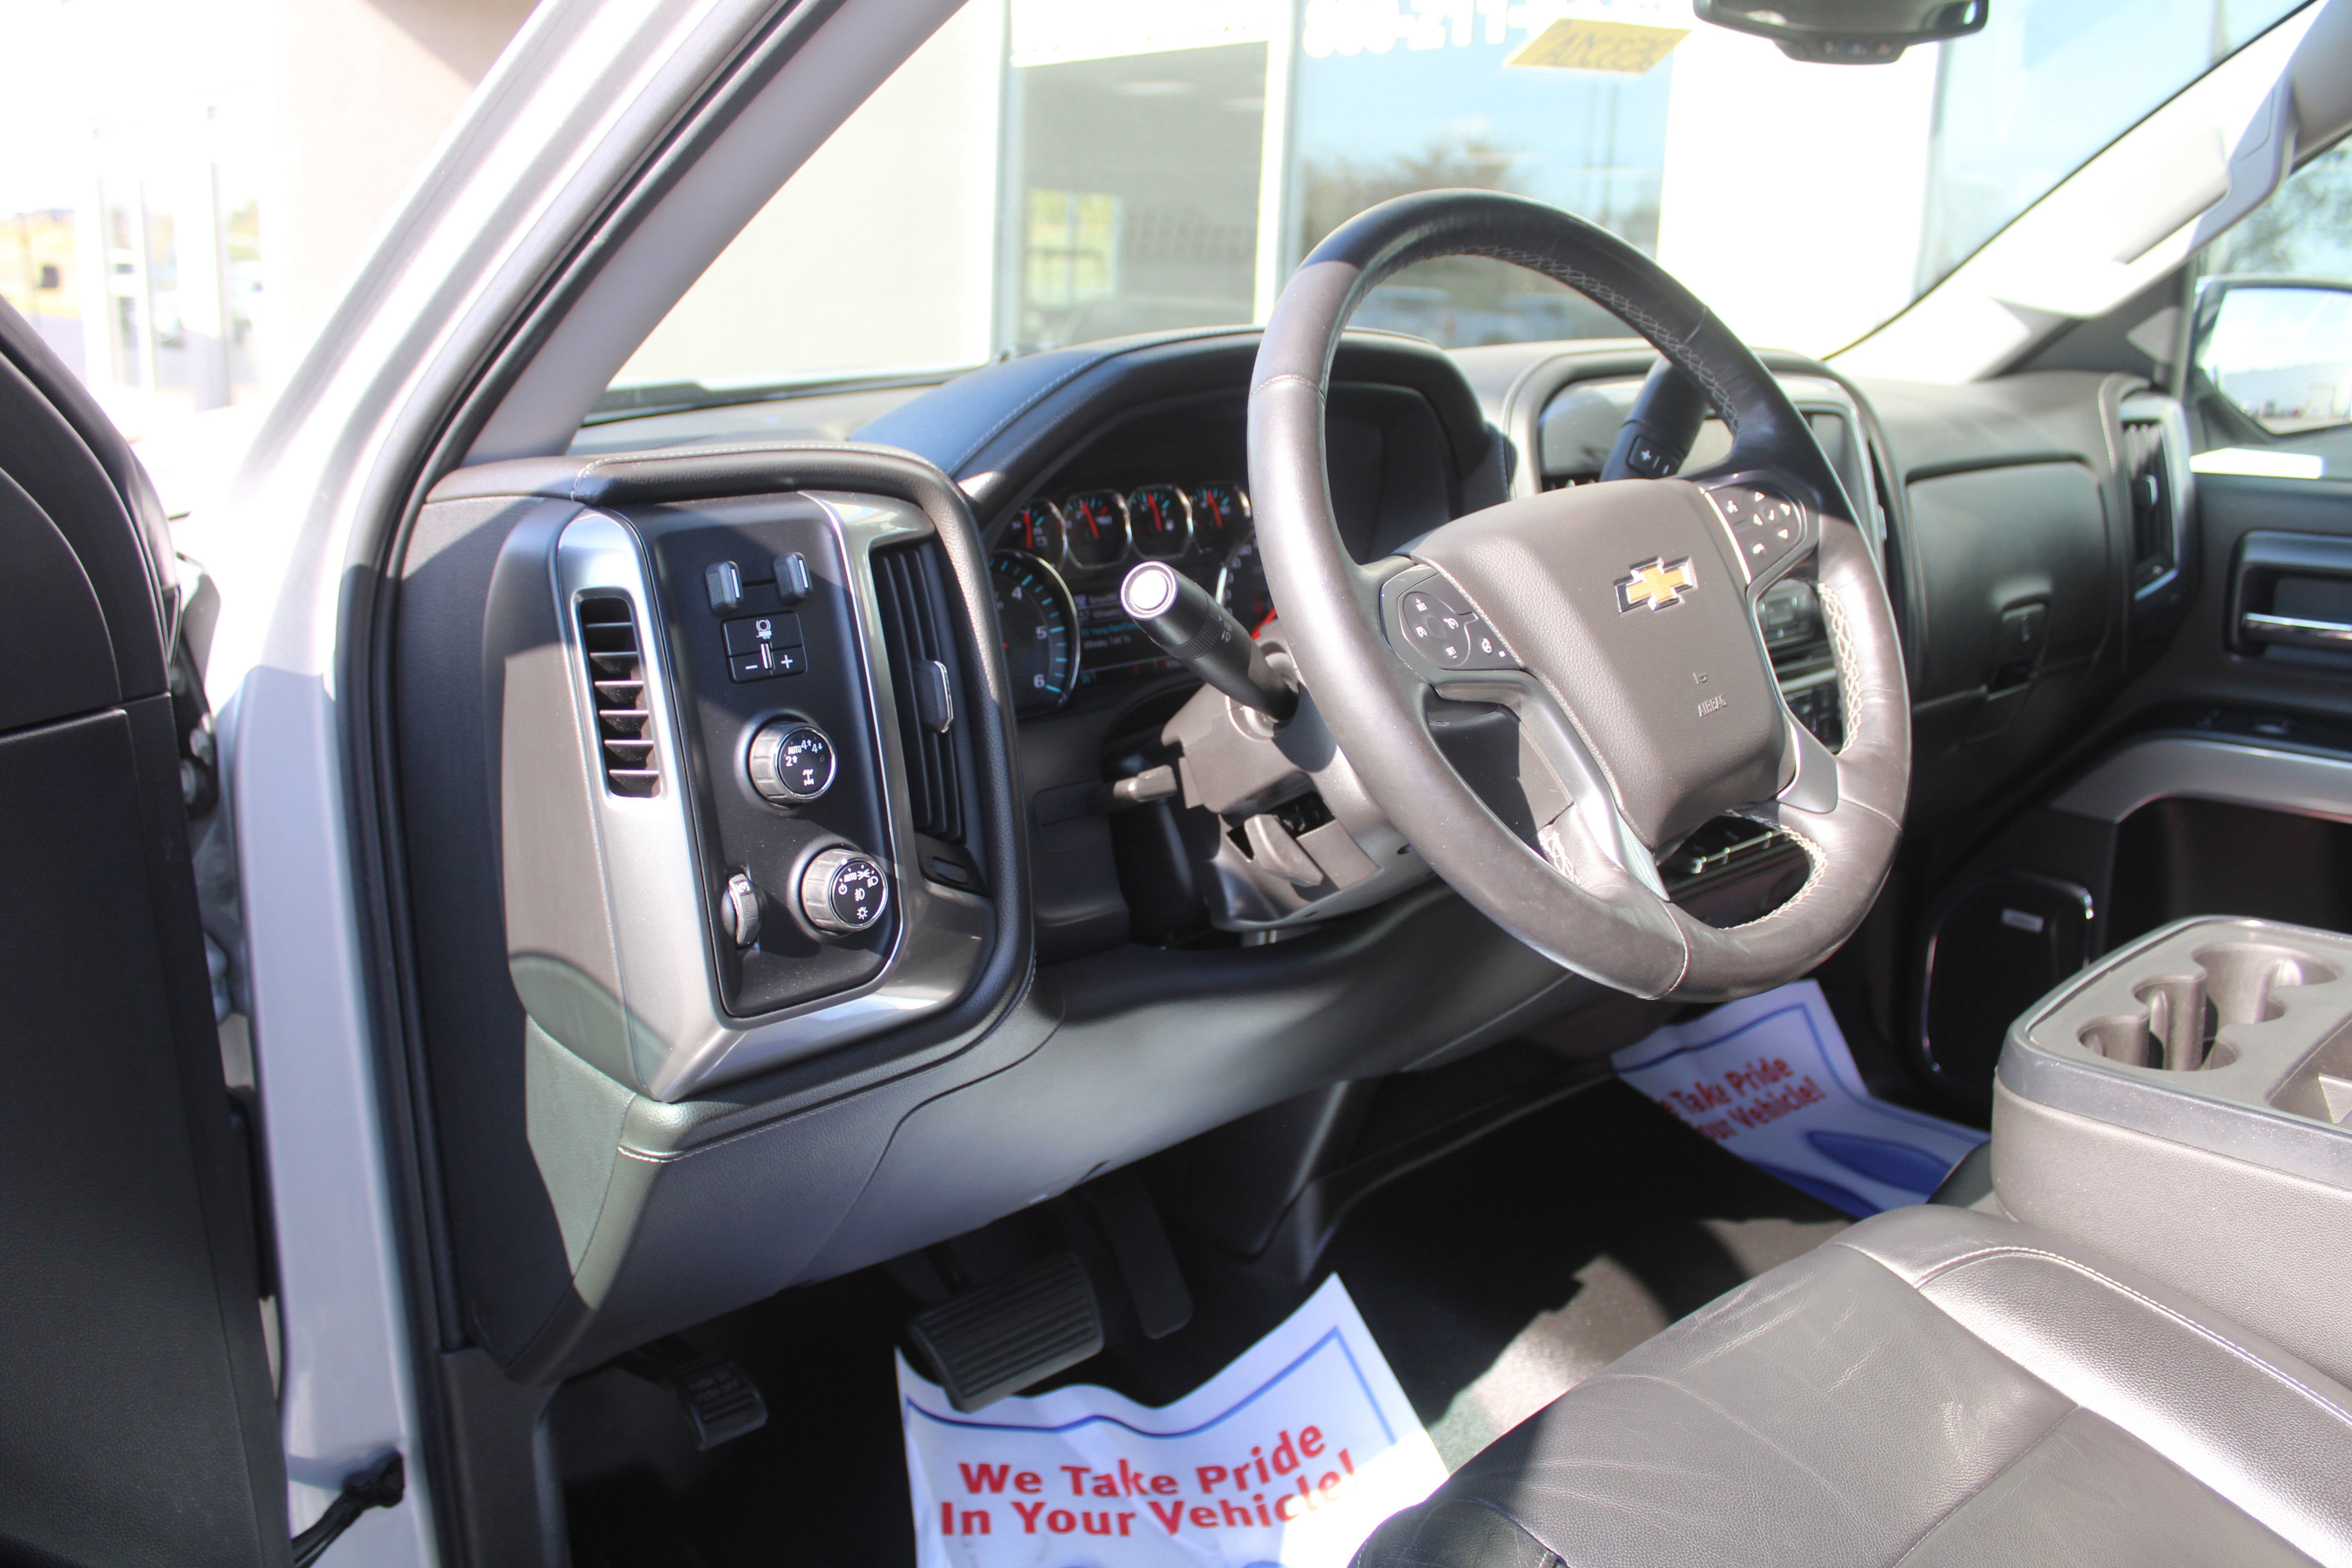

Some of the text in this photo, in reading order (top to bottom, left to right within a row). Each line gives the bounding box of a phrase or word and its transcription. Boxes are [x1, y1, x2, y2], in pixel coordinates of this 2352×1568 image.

[1011, 586, 1022, 600] 4
[1036, 626, 1047, 640] 5
[1033, 674, 1045, 688] 6
[1698, 695, 1727, 717] AIRBAG
[788, 745, 802, 755] AUTO
[801, 739, 808, 750] 4
[811, 743, 818, 753] 4
[785, 756, 793, 767] 2
[844, 872, 857, 883] AUTO
[1668, 1080, 1732, 1112] Take
[1724, 1057, 1793, 1096] Pride
[1726, 1076, 1826, 1129] Vehicle!
[958, 1425, 1326, 1497] We Take Pride
[941, 1448, 1359, 1537] In Your Vehicle!
